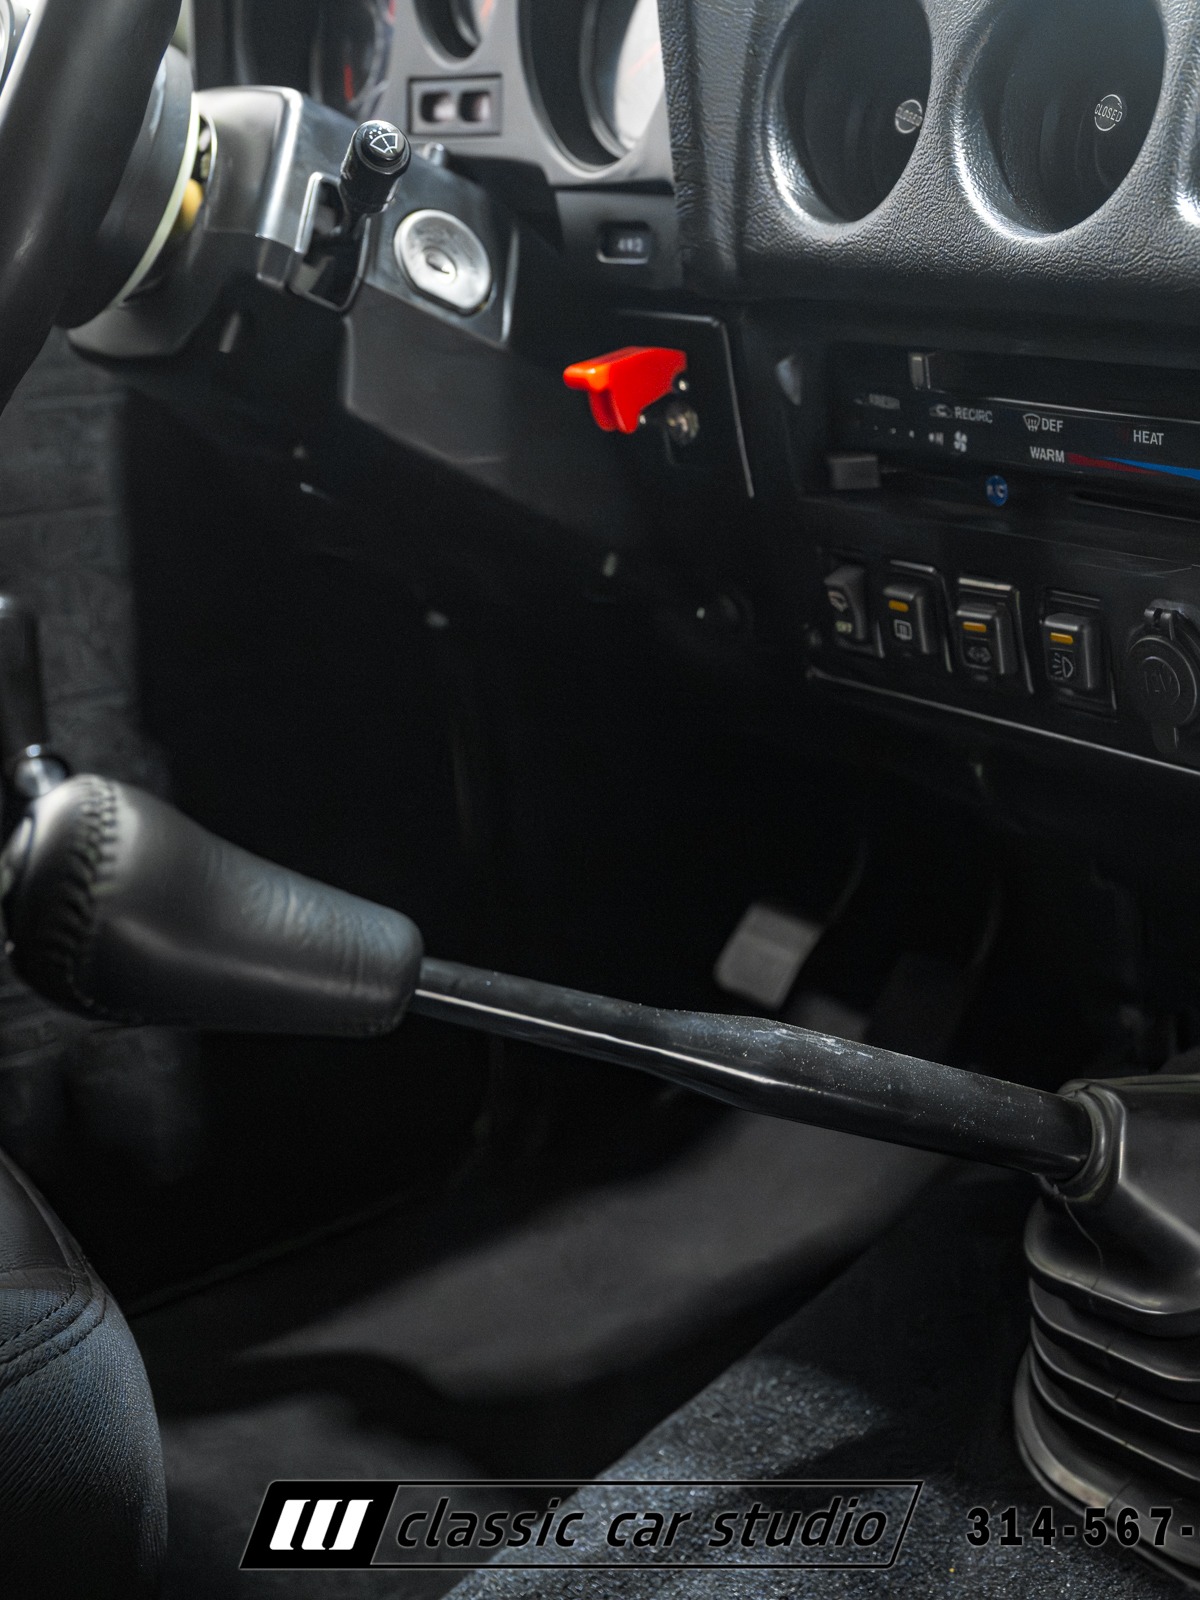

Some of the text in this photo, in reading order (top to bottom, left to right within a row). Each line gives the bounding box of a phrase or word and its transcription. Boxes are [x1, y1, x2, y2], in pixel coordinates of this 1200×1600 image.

[1094, 103, 1123, 123] CLOSED
[954, 406, 993, 424] RECIRC
[1041, 418, 1064, 434] DEF
[1133, 430, 1164, 446] HEAT
[1029, 446, 1065, 464] WARM
